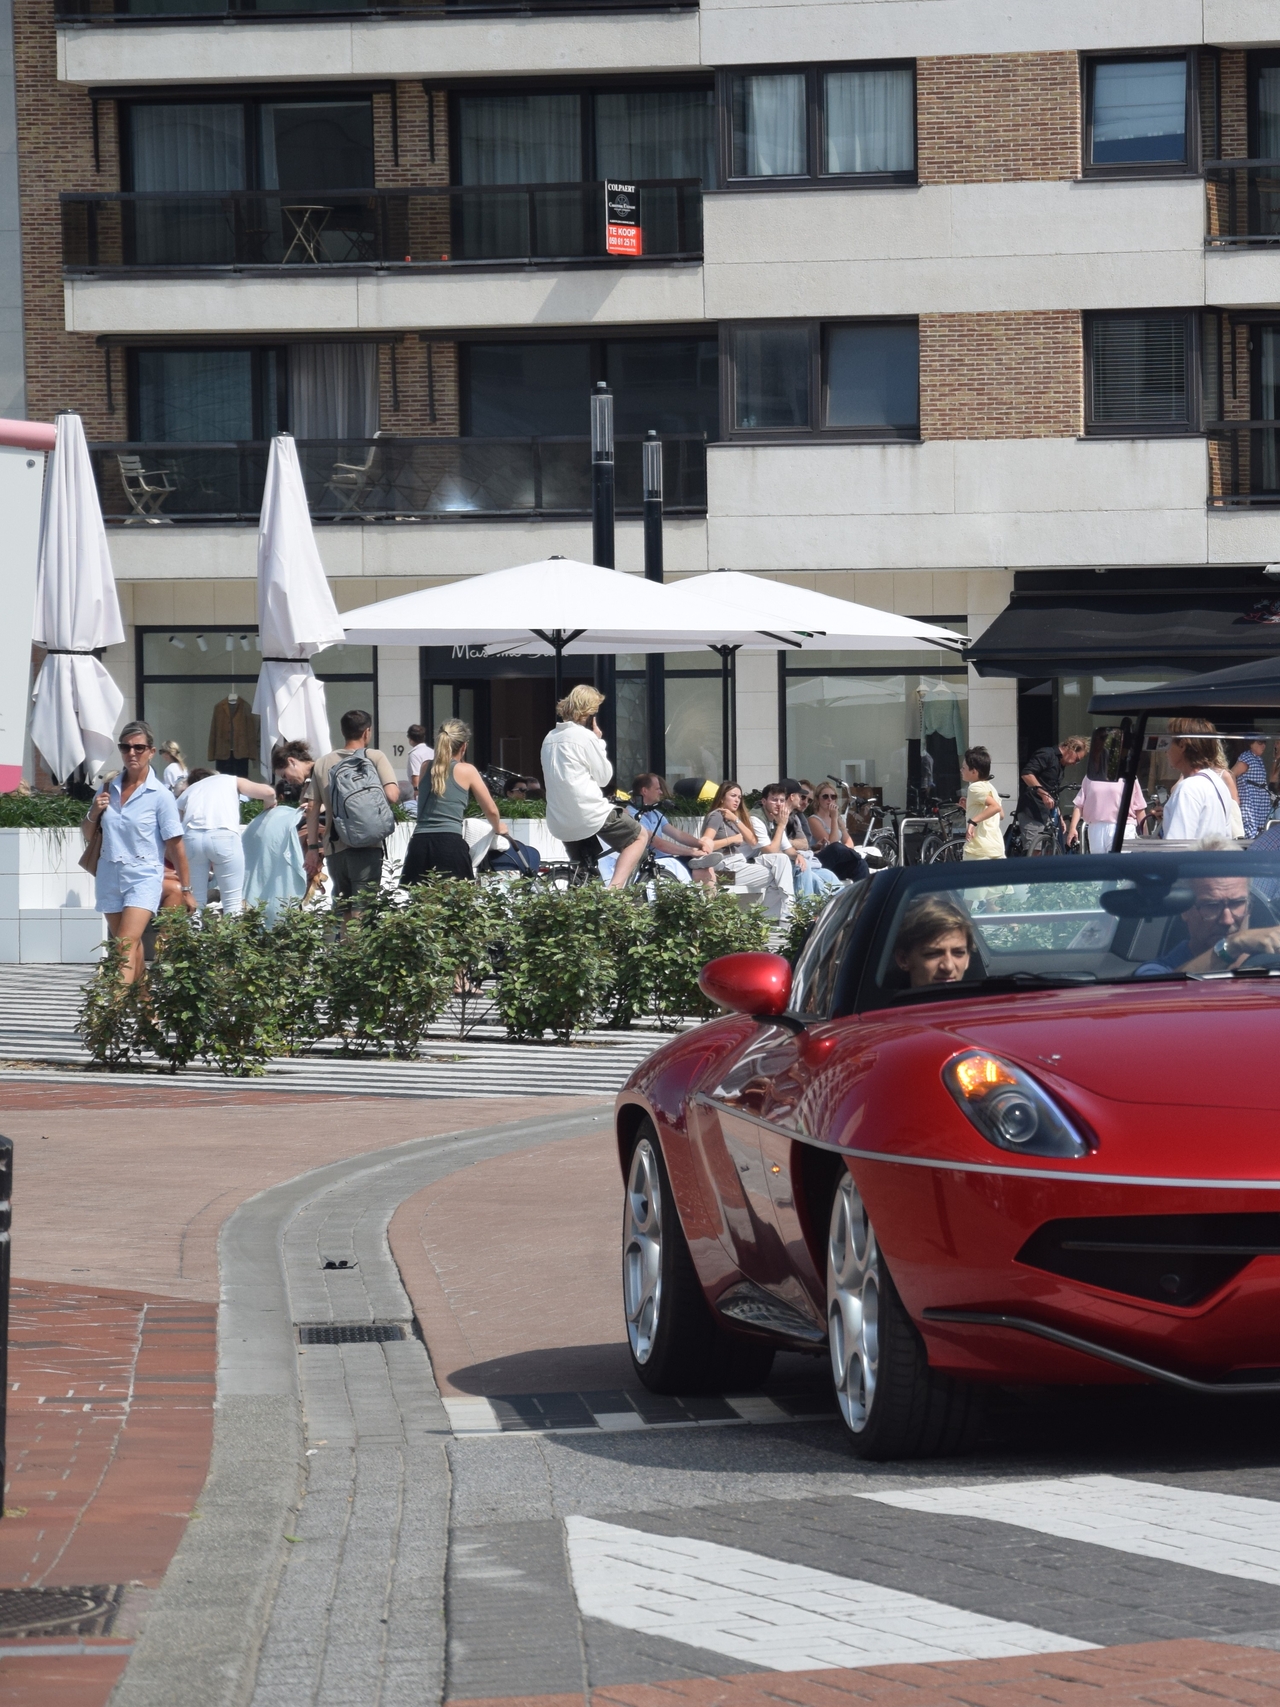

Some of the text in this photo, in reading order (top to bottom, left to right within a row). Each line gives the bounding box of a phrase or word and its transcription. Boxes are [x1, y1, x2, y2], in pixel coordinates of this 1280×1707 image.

[608, 184, 635, 193] COLPAERT
[609, 227, 636, 237] TE KOOP
[392, 744, 405, 757] 19
